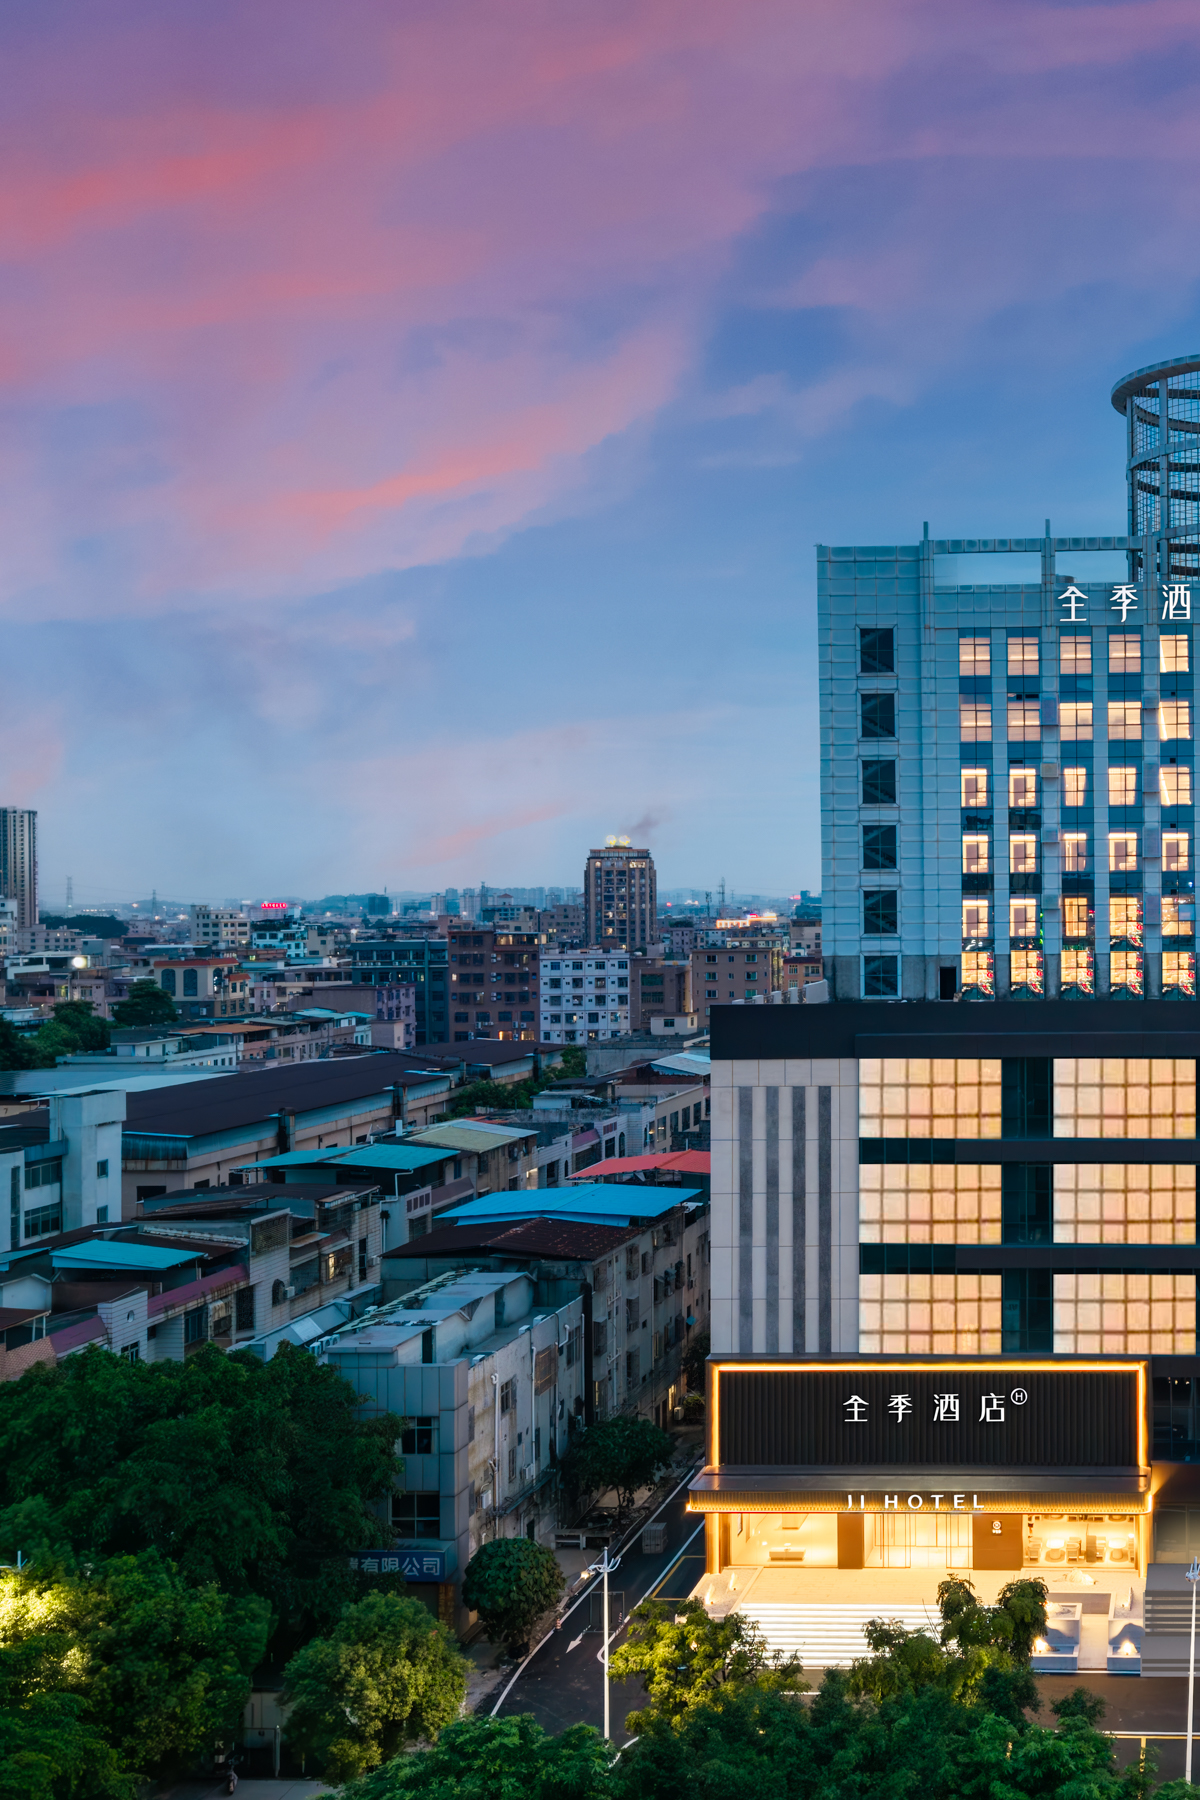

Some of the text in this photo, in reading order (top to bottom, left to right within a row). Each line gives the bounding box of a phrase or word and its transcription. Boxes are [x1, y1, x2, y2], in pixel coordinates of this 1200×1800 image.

[843, 1392, 1006, 1423] 全季酒店
[847, 1494, 985, 1509] JI HOTEL
